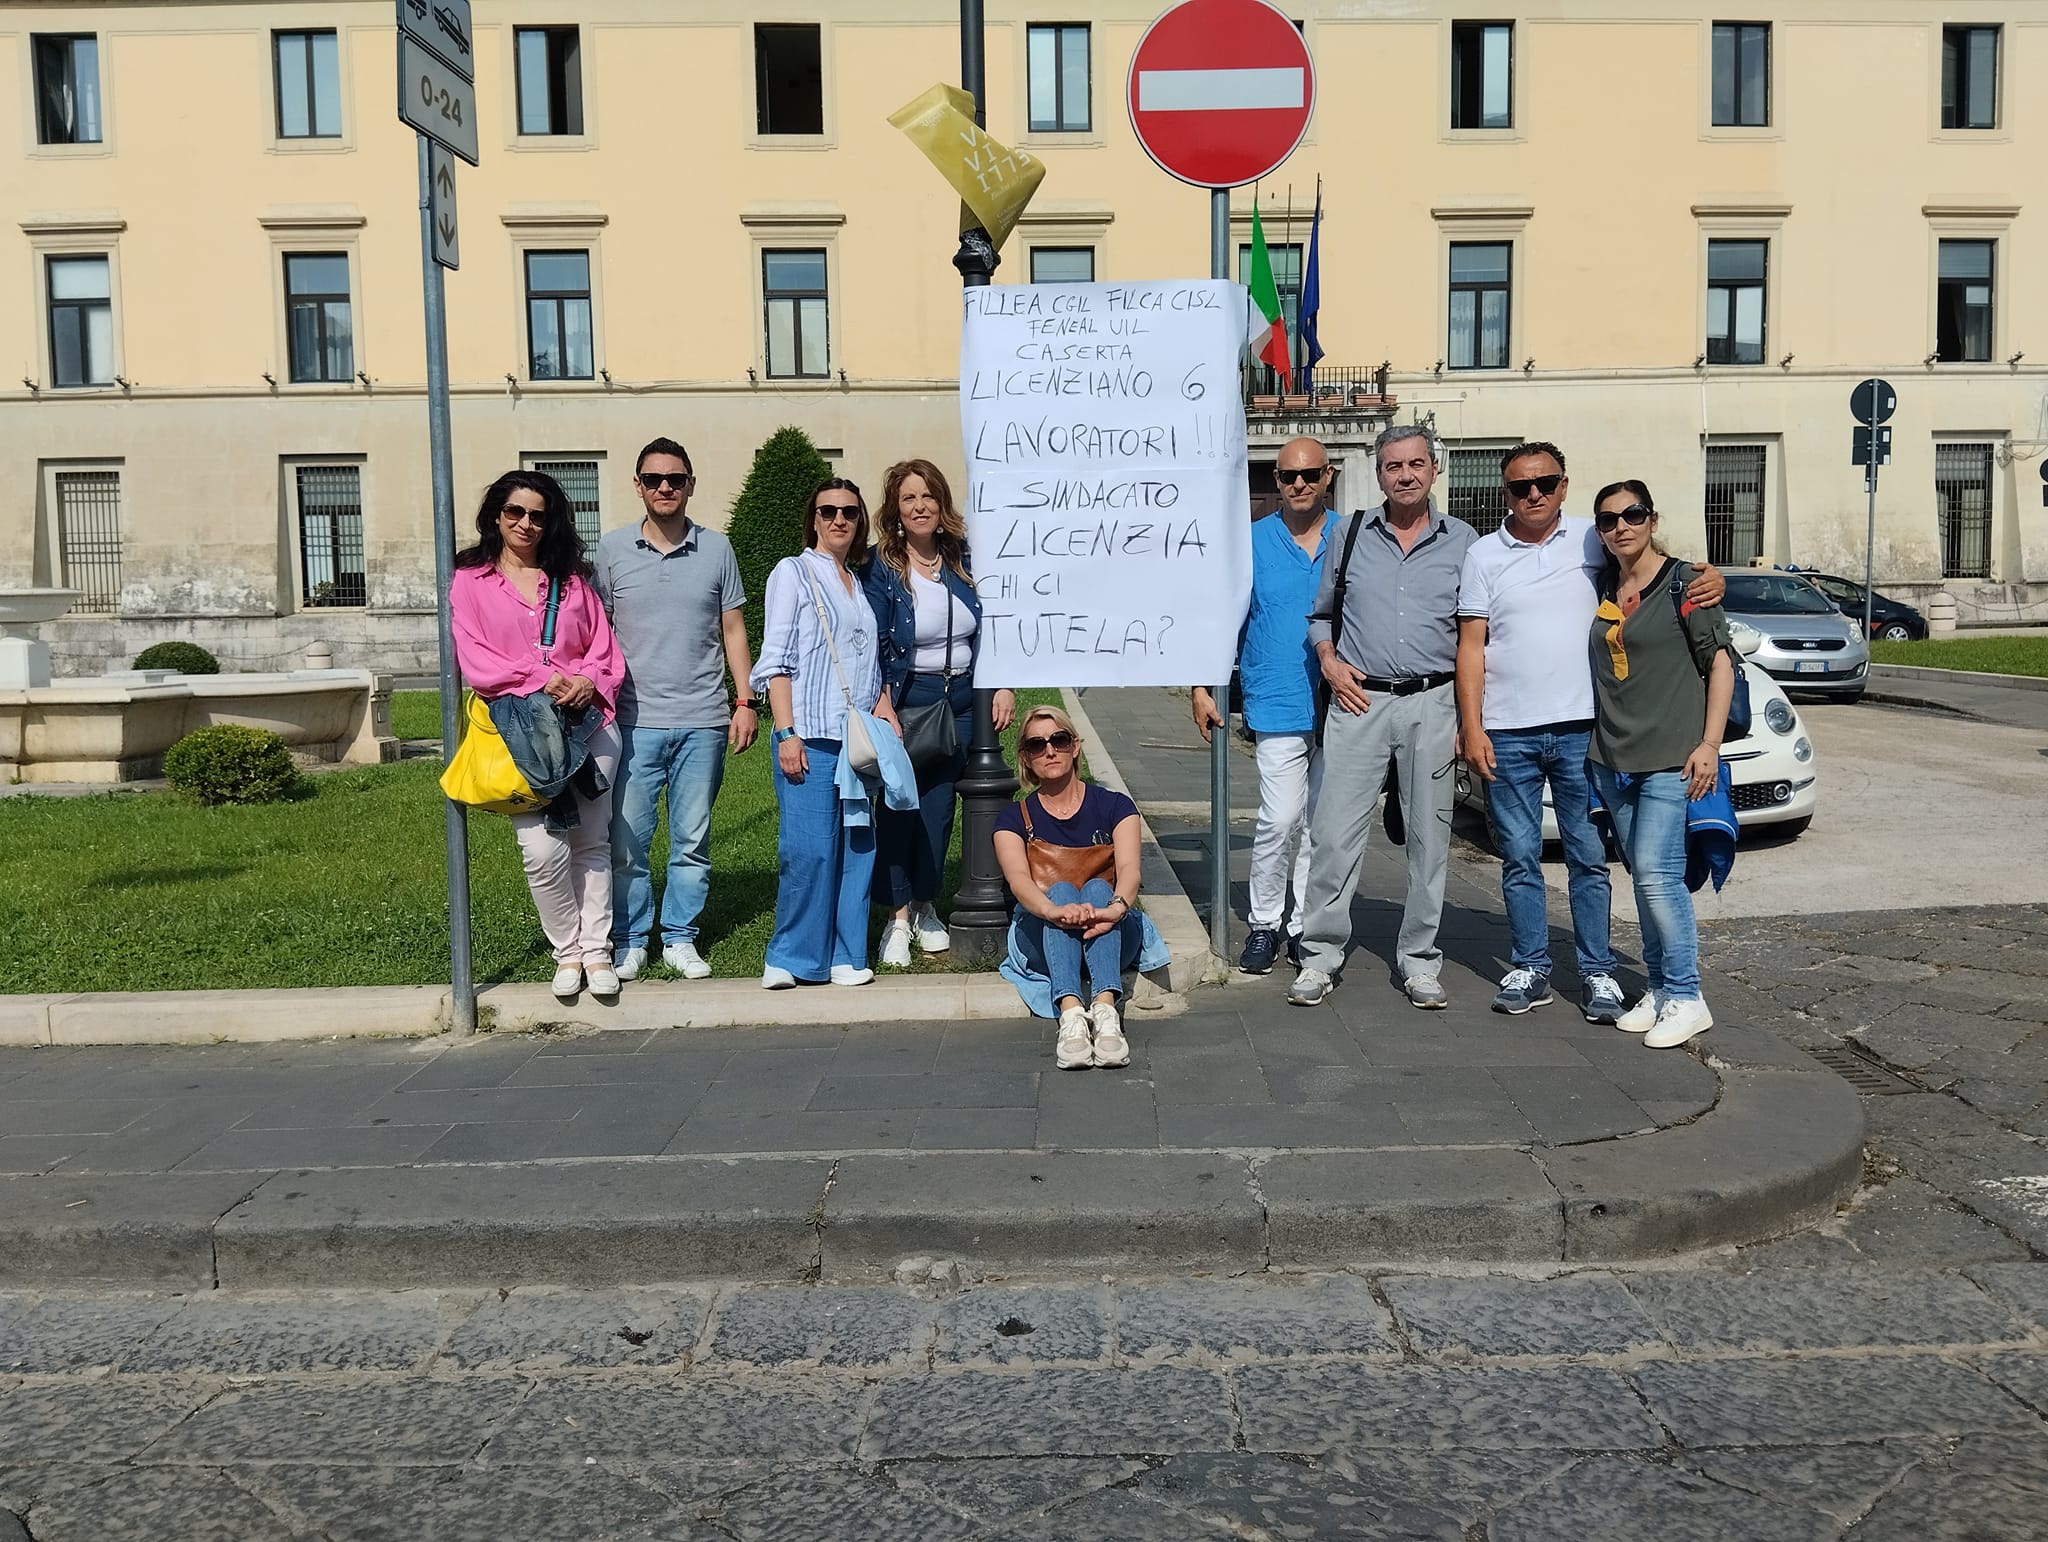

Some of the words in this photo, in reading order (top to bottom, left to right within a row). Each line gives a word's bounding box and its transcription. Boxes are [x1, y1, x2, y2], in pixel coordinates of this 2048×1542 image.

[420, 75, 463, 128] 0-24
[963, 289, 1043, 321] FILLEA
[1052, 294, 1092, 313] CGIL
[1106, 288, 1163, 312] FILCA
[1170, 288, 1223, 311] CISL
[1027, 318, 1098, 338] FENEAL
[1110, 318, 1149, 336] UIL
[1016, 343, 1132, 362] CASERTA
[970, 364, 1153, 401] LICENZIANO
[1181, 363, 1206, 401] 6
[972, 480, 996, 513] IL
[1002, 478, 1179, 512] SINDACATO
[996, 518, 1208, 560] LICENZIA
[976, 574, 1018, 600] CHI
[1033, 573, 1061, 596] CI
[981, 612, 1175, 658] TUTELA?
